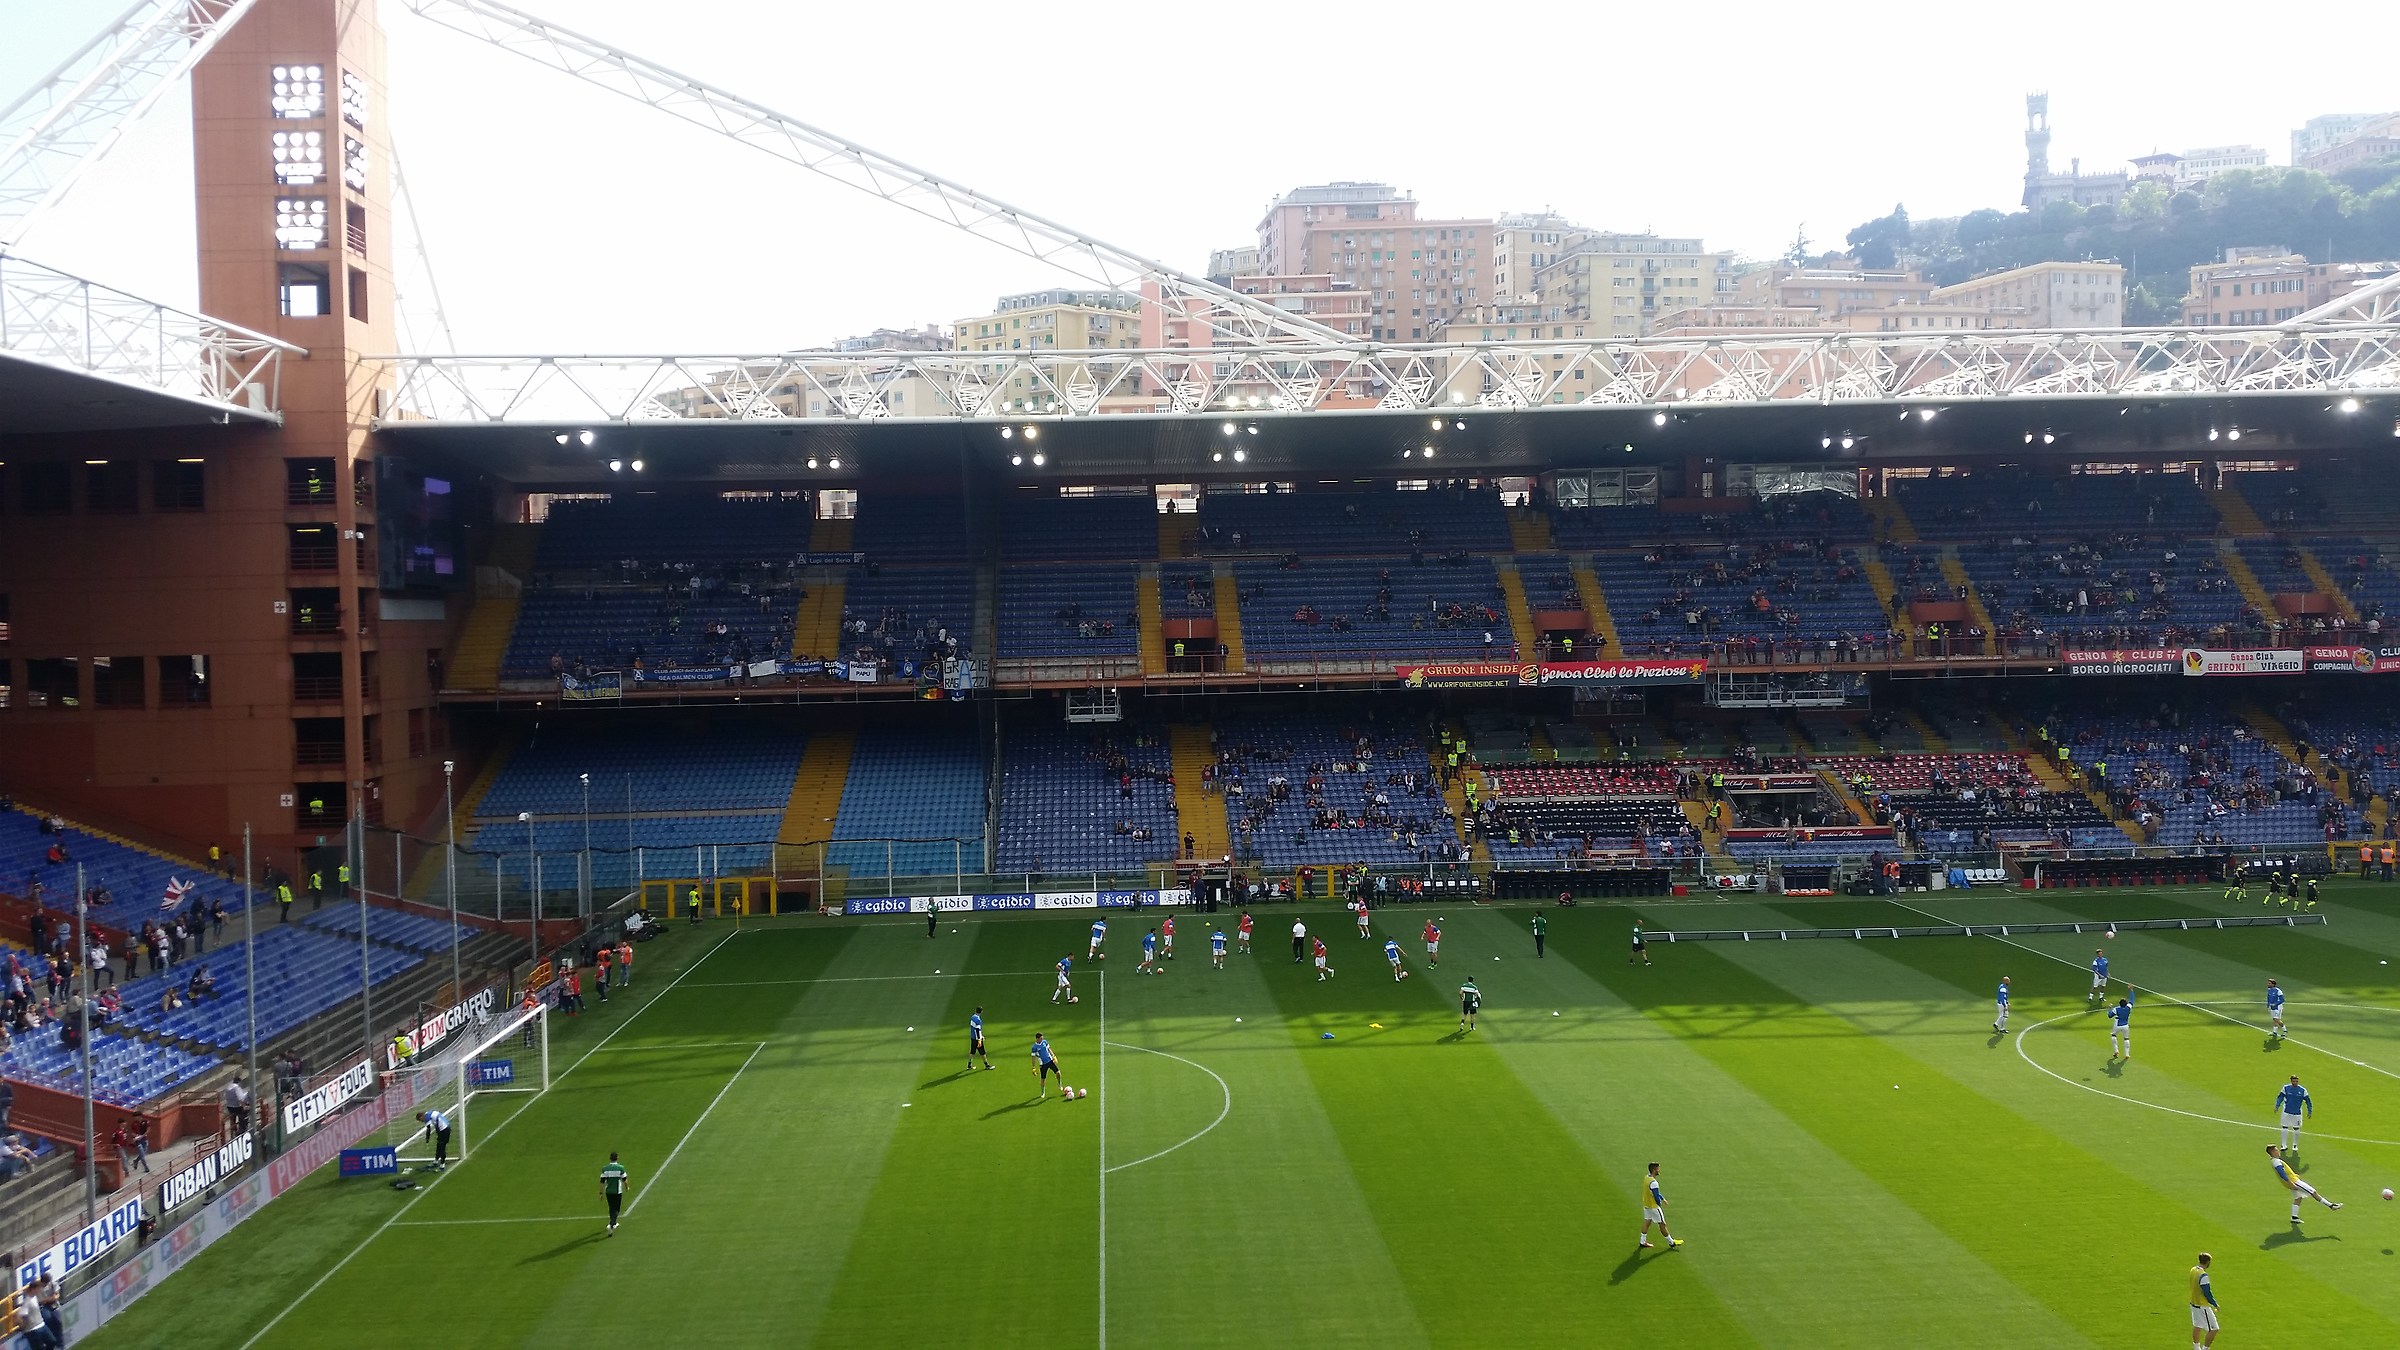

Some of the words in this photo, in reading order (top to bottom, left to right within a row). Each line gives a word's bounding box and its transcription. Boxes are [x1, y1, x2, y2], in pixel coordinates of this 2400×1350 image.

[2069, 651, 2107, 661] GENOA
[2131, 650, 2163, 659] CLUB
[2255, 652, 2274, 661] Club
[2315, 649, 2349, 658] GENOA
[1427, 666, 1476, 675] GRIFONE
[1480, 665, 1519, 674] INSIDE
[2072, 665, 2110, 675] BORGO
[2112, 663, 2172, 674] INCROCIATI
[2207, 662, 2246, 672] GRIFONI
[2260, 661, 2299, 671] VIAGGIO
[2313, 662, 2353, 671] COMPAGNIA
[1541, 667, 1582, 683] Genoa
[1584, 666, 1617, 679] Club
[1618, 667, 1634, 678] le
[1634, 665, 1687, 678] Preziose
[1427, 680, 1509, 688] WWW.GRIFONEINSIDE.NET
[935, 897, 969, 910] gidio
[990, 896, 1031, 909] egidio
[1053, 894, 1093, 907] egidio
[1115, 892, 1155, 906] egiio
[865, 900, 906, 913] egidio
[445, 987, 493, 1031] GRAFFIO
[483, 1066, 510, 1079] TIM
[290, 1090, 328, 1128] FIFTY
[339, 1064, 369, 1099] FOUR
[362, 1153, 394, 1170] TIM
[163, 1153, 217, 1211] URBAN
[219, 1132, 253, 1176] RING
[64, 1198, 140, 1273] BOARD
